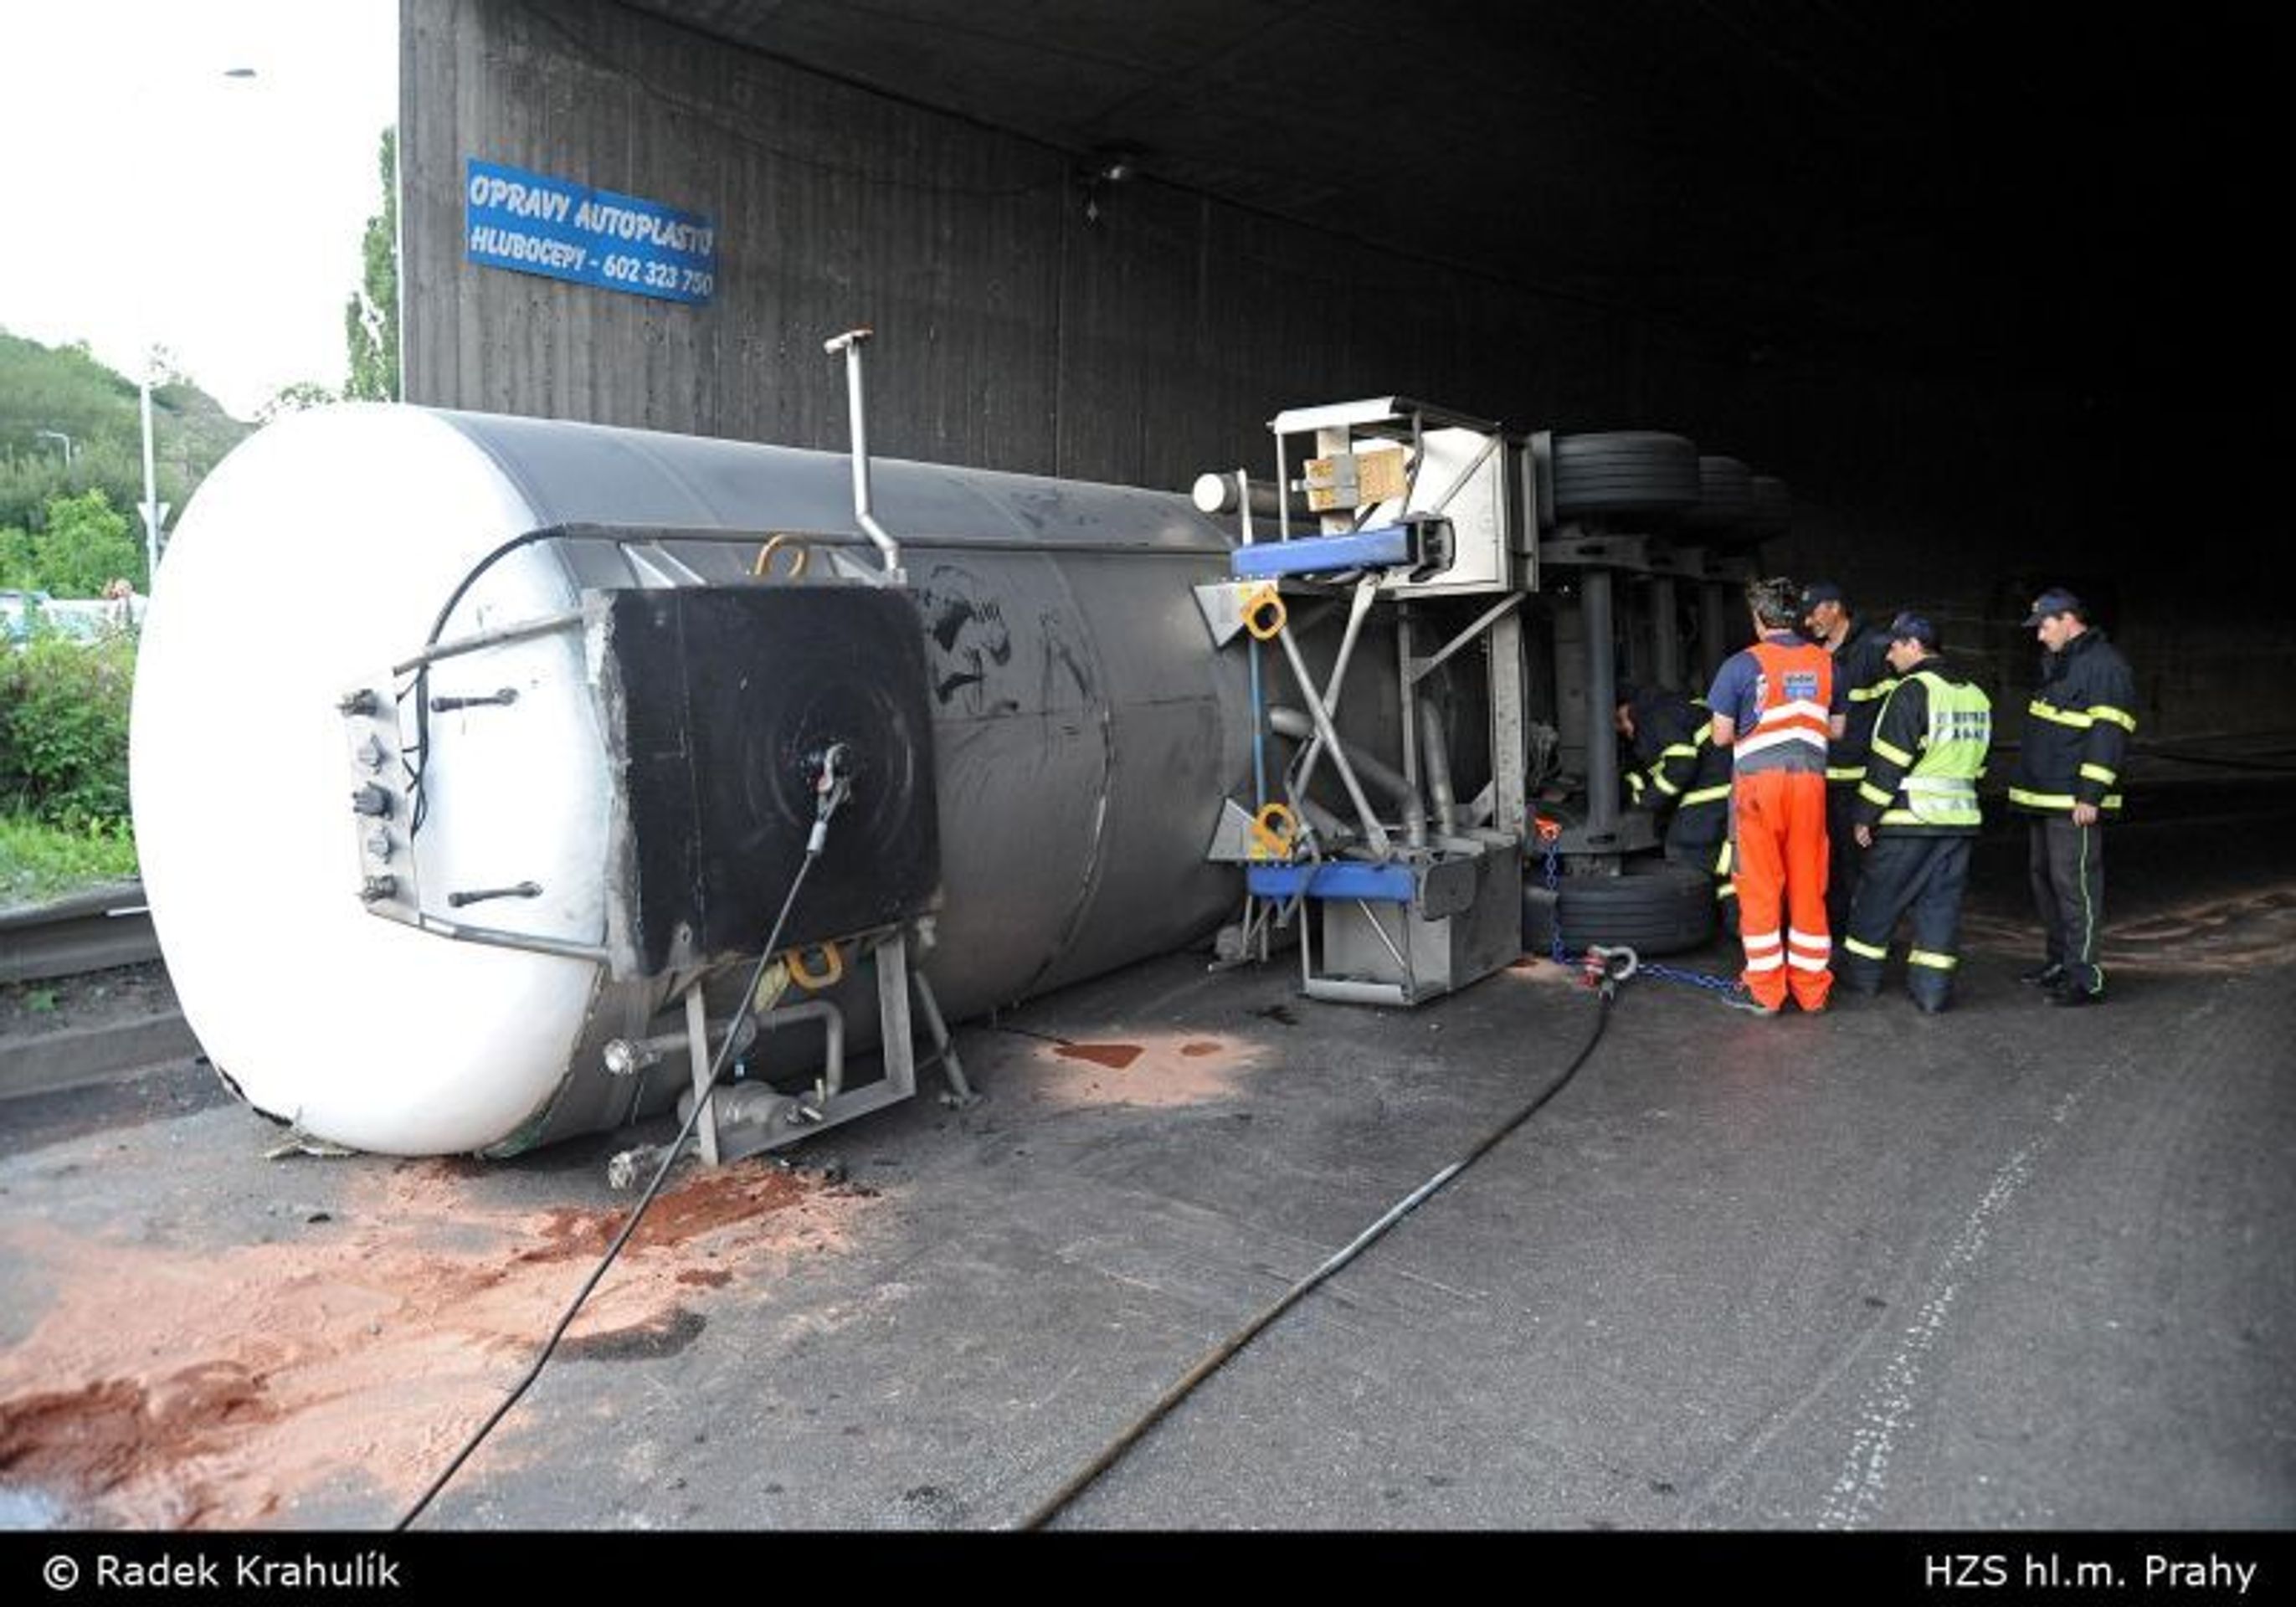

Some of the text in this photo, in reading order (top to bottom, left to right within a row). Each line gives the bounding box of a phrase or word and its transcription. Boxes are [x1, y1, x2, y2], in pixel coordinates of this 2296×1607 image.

[470, 174, 571, 223] OPRAVY
[602, 254, 639, 281] 602
[644, 261, 678, 289] 323
[681, 269, 714, 296] 750
